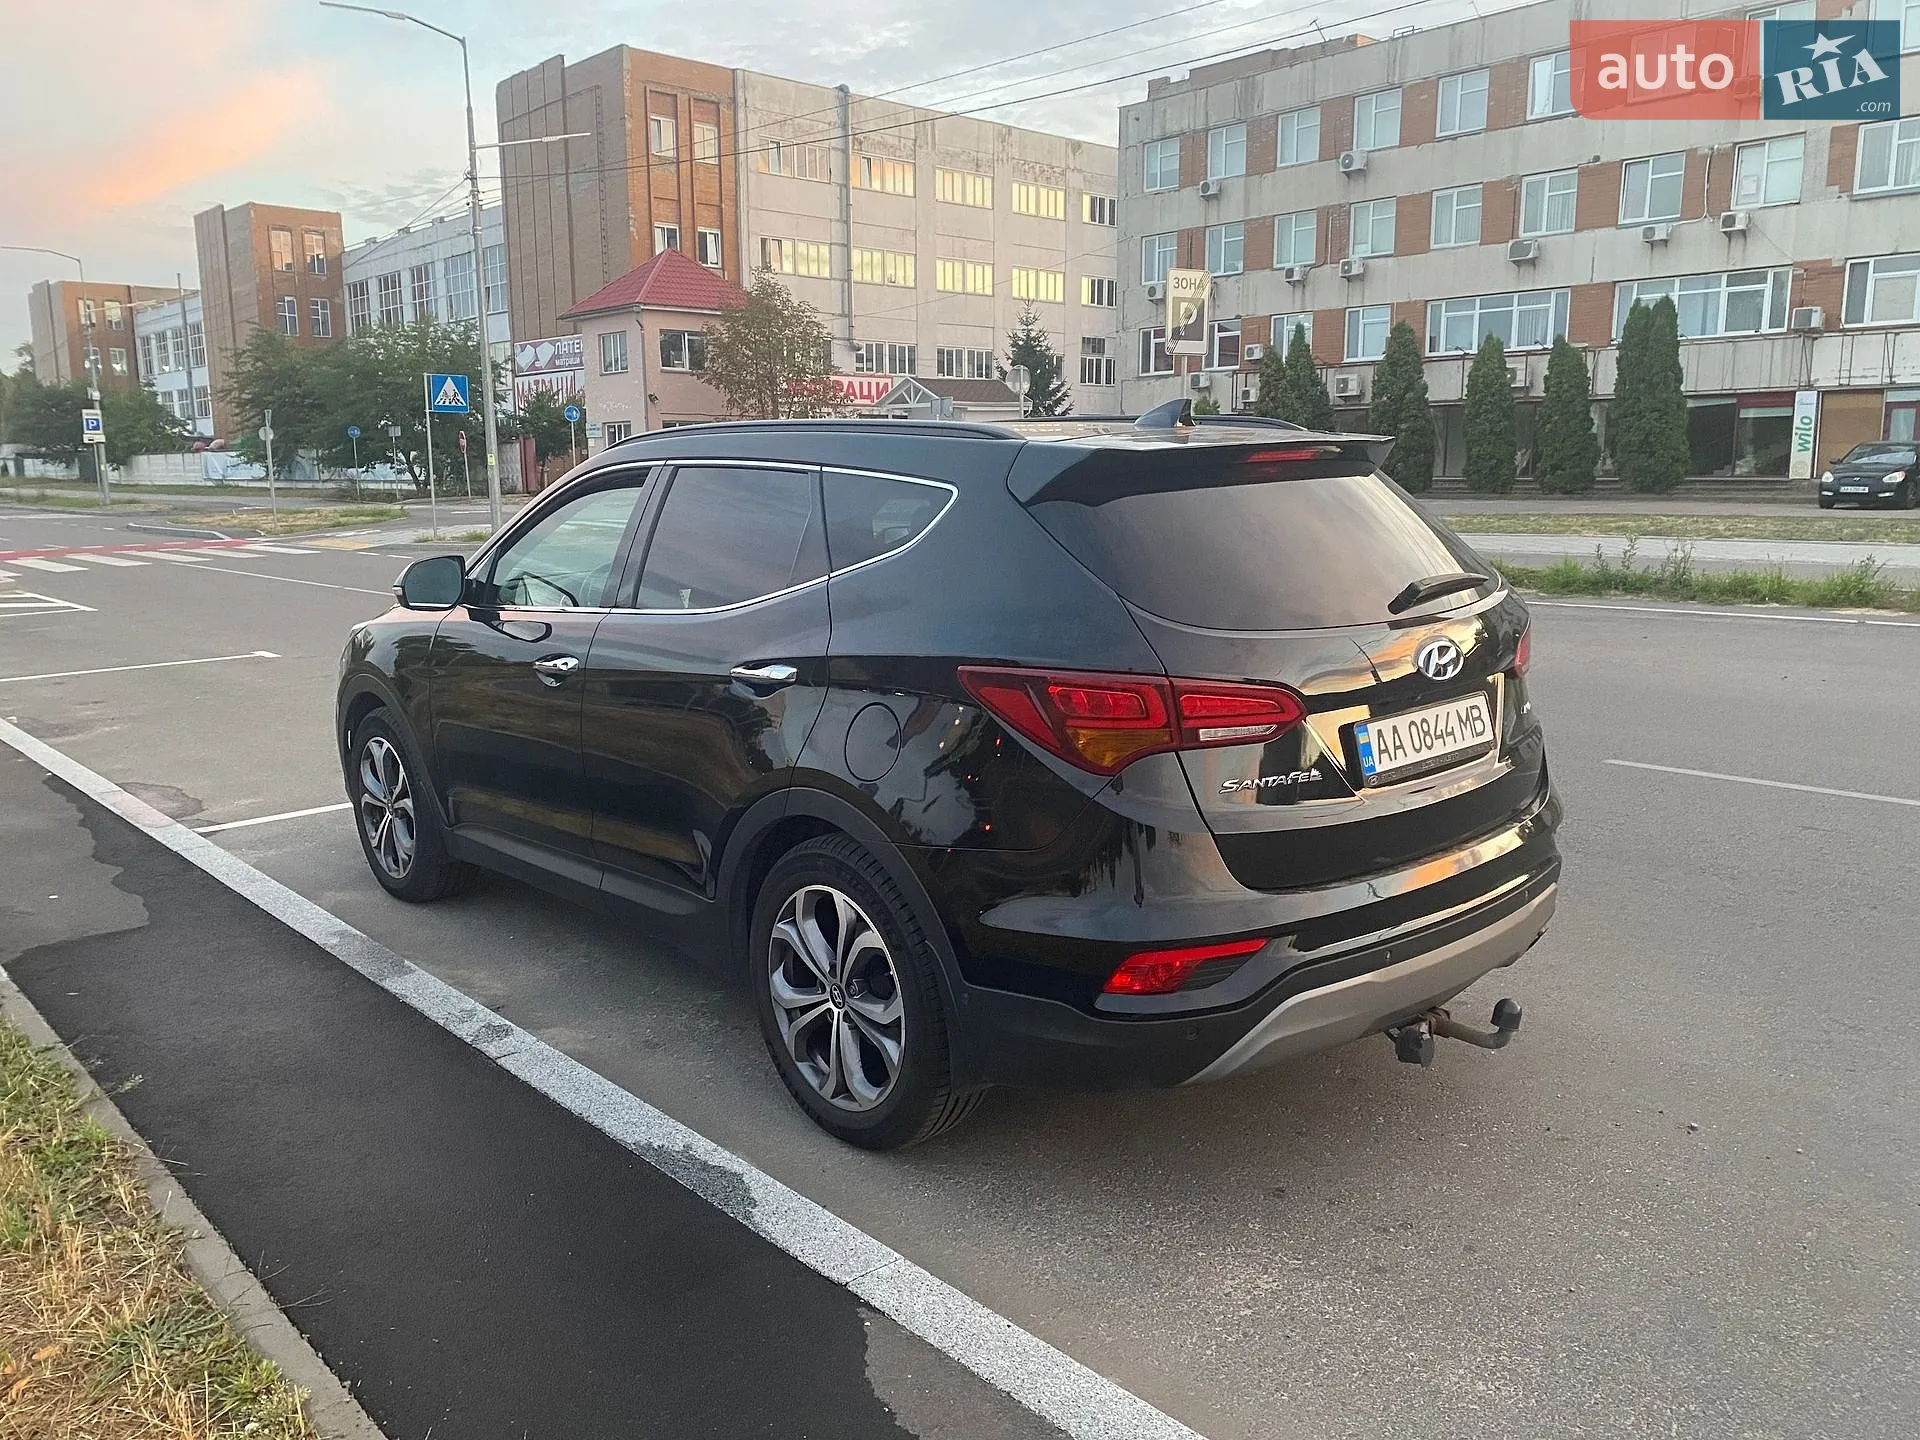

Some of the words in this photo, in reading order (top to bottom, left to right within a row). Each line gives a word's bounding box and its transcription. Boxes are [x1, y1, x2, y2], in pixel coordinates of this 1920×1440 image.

[1795, 415, 1813, 453] wilo
[1376, 724, 1407, 765] AA
[1408, 711, 1457, 754] 0844
[1456, 704, 1486, 741] MB
[1362, 756, 1375, 768] UA
